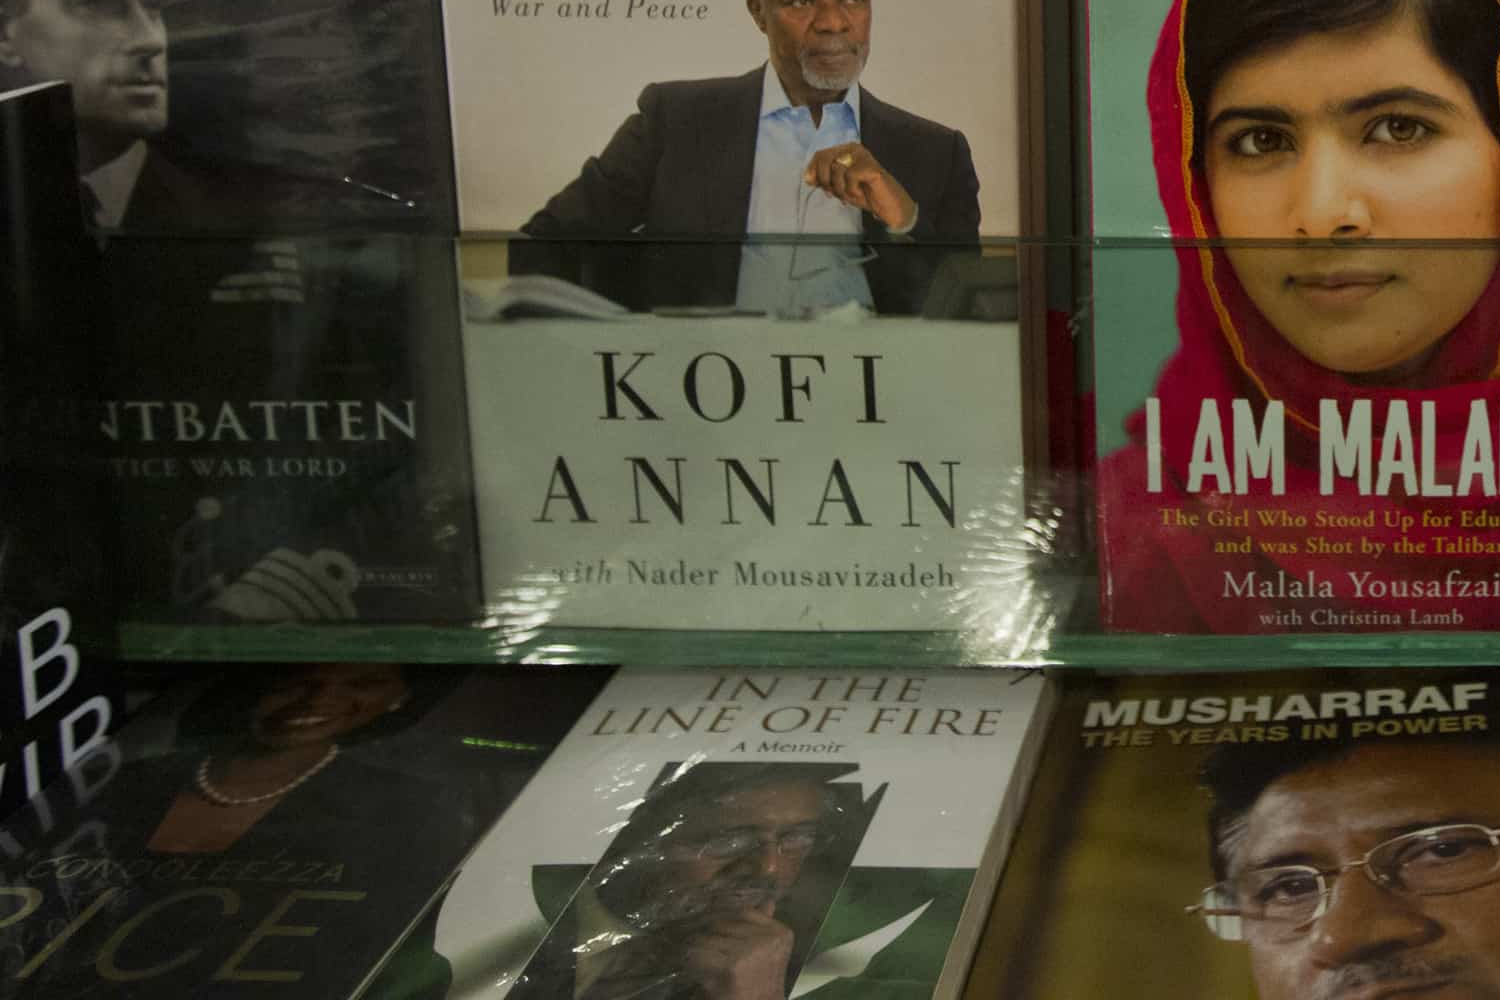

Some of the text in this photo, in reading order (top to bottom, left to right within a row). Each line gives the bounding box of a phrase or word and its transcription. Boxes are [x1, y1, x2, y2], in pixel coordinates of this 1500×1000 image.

[593, 351, 887, 423] KOFI
[1145, 397, 1163, 493] I
[1187, 397, 1285, 495] AM
[189, 457, 257, 478] WAR
[266, 457, 348, 478] LORD
[532, 456, 962, 528] ANNAN
[1159, 509, 1200, 528] The
[1208, 509, 1249, 528] Girl
[1258, 510, 1306, 528] Who
[1315, 509, 1376, 528] Stood
[1384, 511, 1414, 532] Up
[1422, 509, 1452, 528] for
[1215, 536, 1252, 554] and
[1260, 541, 1298, 554] was
[1306, 536, 1352, 554] Shot
[1360, 536, 1386, 559] by
[1393, 536, 1426, 554] the
[553, 560, 954, 588] with Nader Mousavizadeh
[1222, 570, 1500, 599] Malala Yousafzai
[1259, 608, 1464, 626] with Christina Lamb
[706, 676, 929, 702] IN THE
[1083, 682, 1489, 728] MUSHARRAF
[586, 706, 1005, 737] LINE OF FIRE
[1080, 714, 1489, 749] THE YEARS IN POWER
[730, 740, 848, 755] A Memoir
